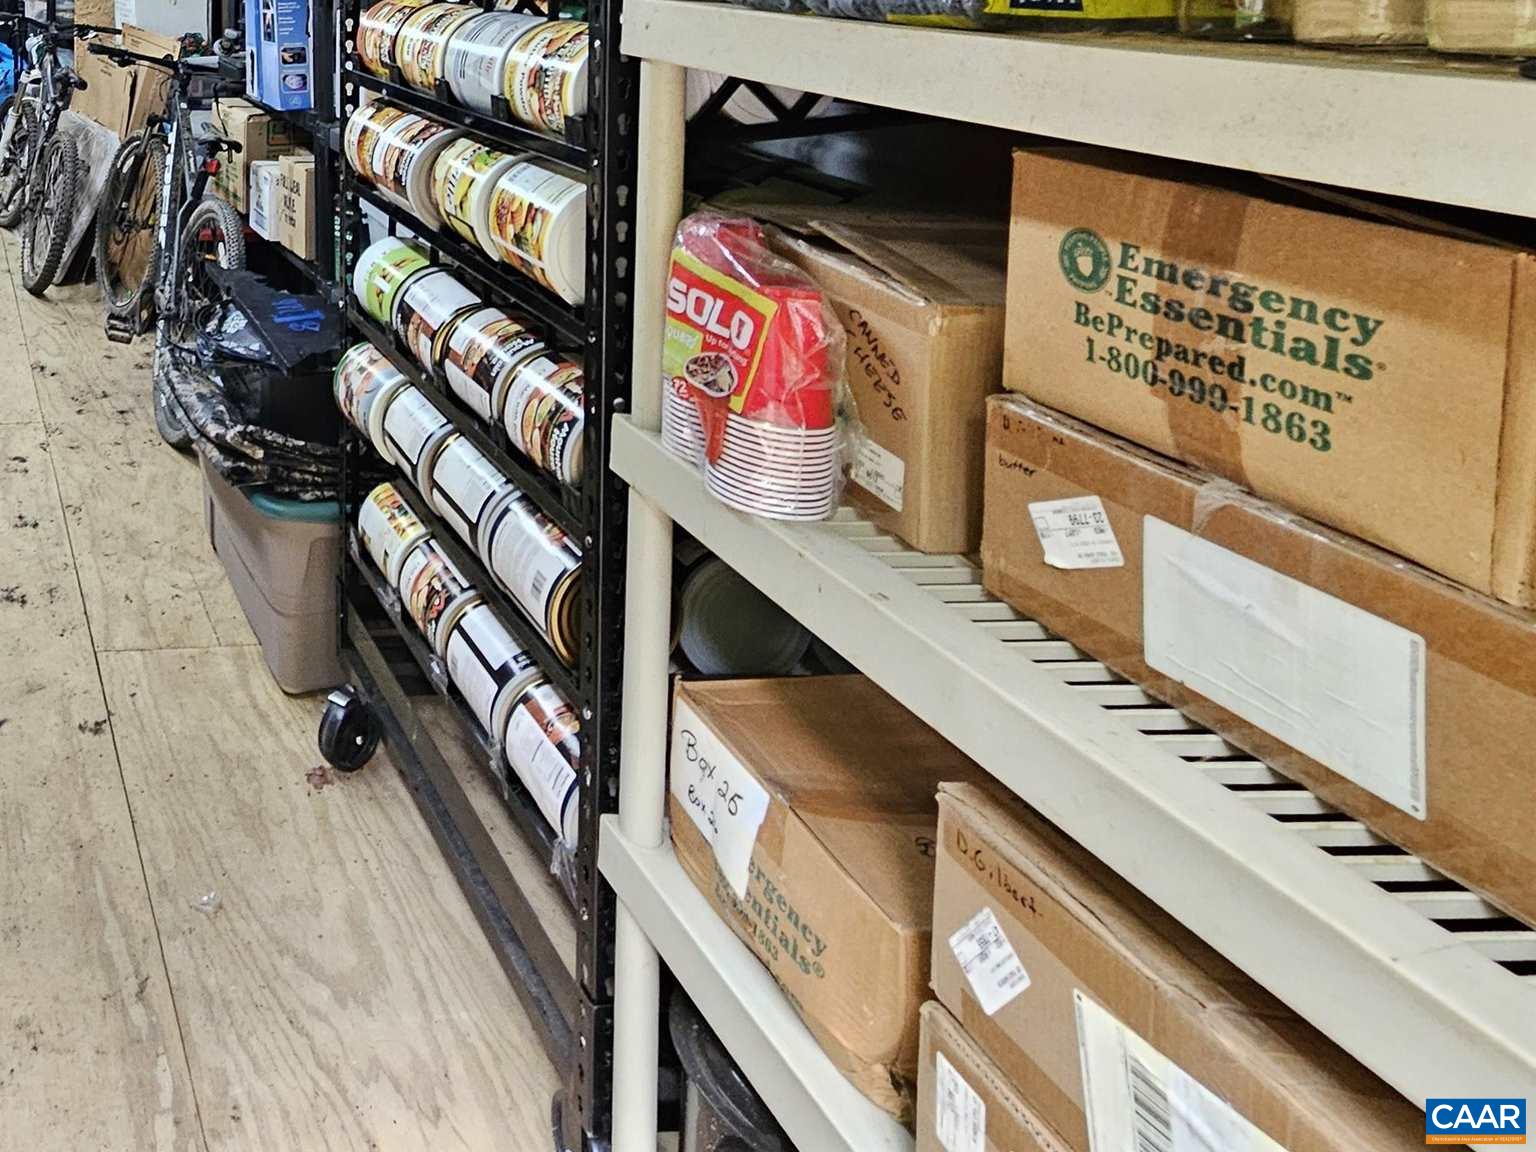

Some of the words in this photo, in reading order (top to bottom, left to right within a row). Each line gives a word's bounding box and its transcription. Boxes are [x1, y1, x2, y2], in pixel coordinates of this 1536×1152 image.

[667, 277, 754, 351] SOLO
[1117, 241, 1384, 347] Emergency
[849, 309, 901, 385] CANNED
[1085, 335, 1332, 452] 1-800-999-1863
[998, 453, 1037, 478] butter
[748, 857, 827, 958] ergency
